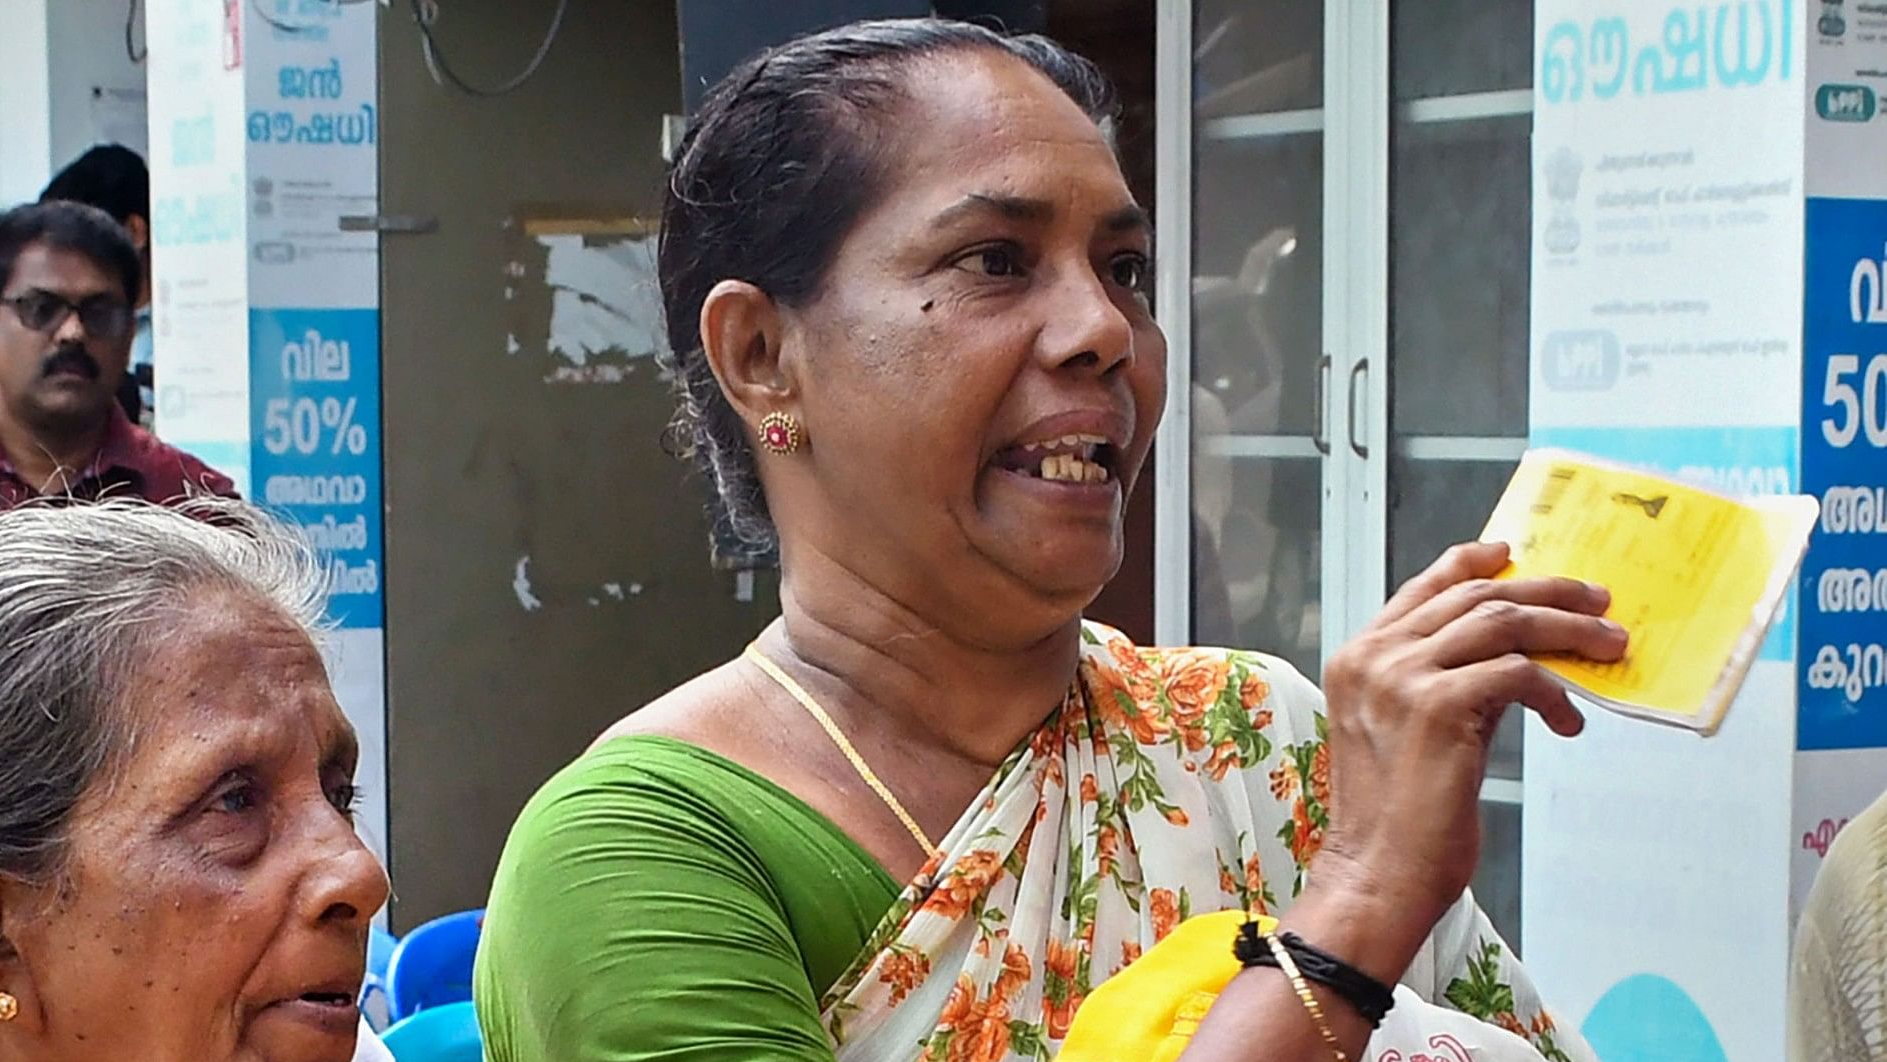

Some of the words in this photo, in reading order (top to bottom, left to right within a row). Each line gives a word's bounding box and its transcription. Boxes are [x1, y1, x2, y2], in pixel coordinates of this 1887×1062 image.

[1542, 0, 1794, 104] ഔഷധി
[247, 102, 374, 146] ഔഷധി
[281, 330, 350, 381] വില
[264, 397, 367, 456] 50%
[1821, 353, 1887, 448] 50
